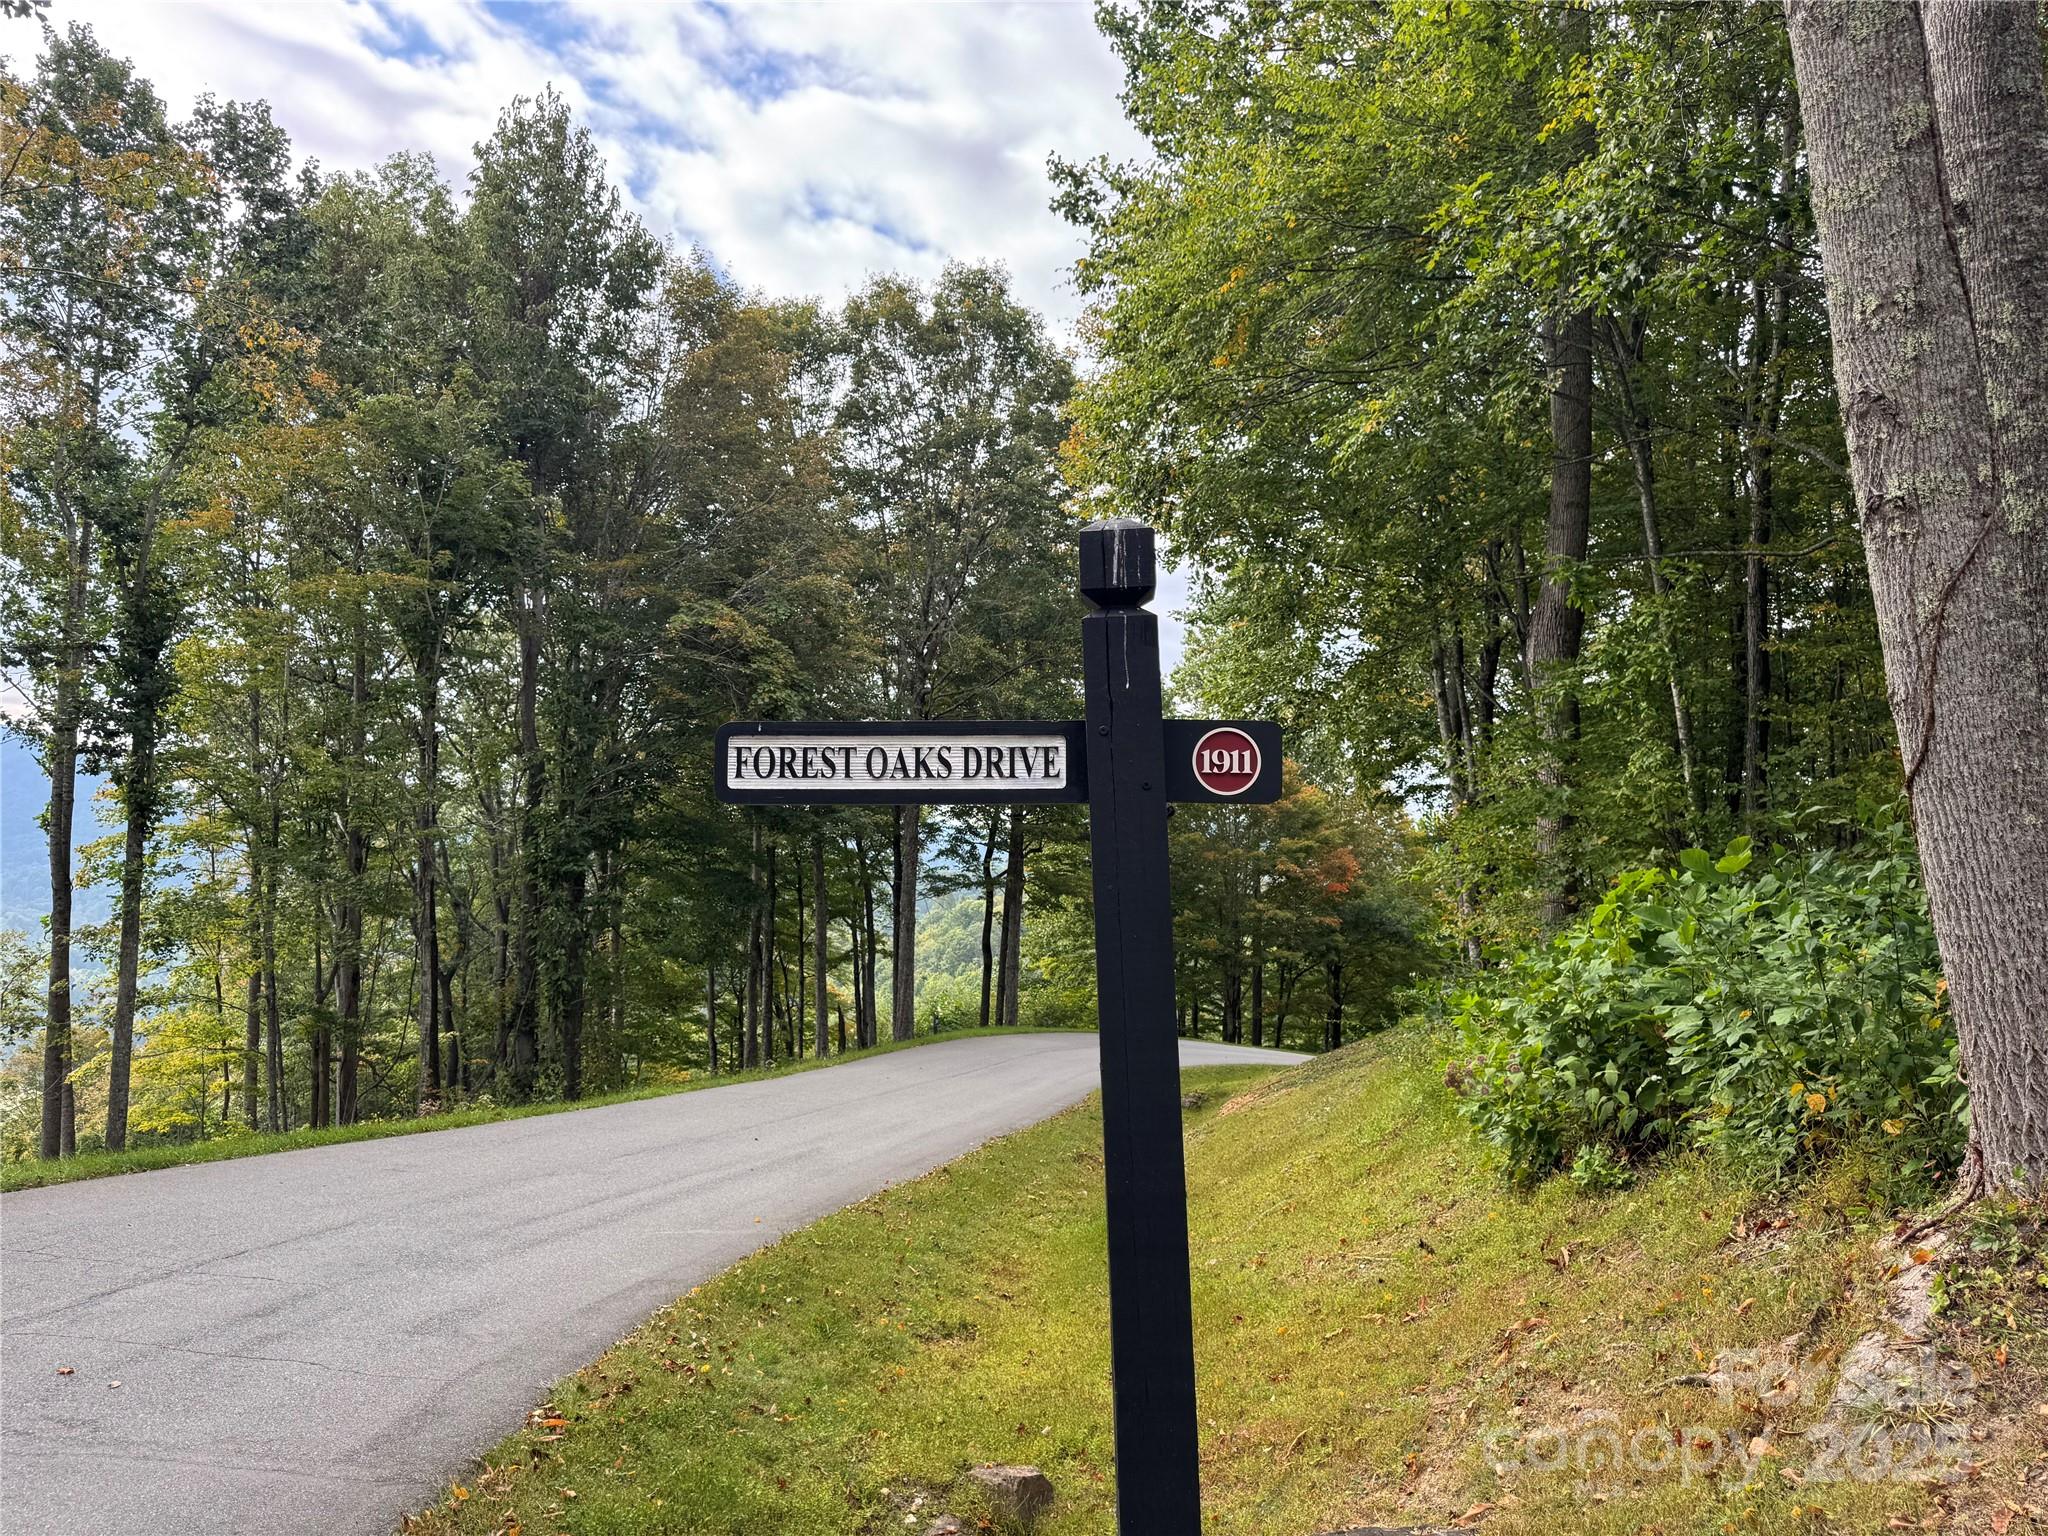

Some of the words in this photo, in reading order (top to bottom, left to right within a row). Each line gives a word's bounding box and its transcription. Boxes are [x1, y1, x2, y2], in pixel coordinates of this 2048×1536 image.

[735, 746, 857, 779] FOREST
[866, 746, 952, 779] OAKS
[961, 746, 1061, 778] DRIVE
[1201, 749, 1253, 774] 1911
